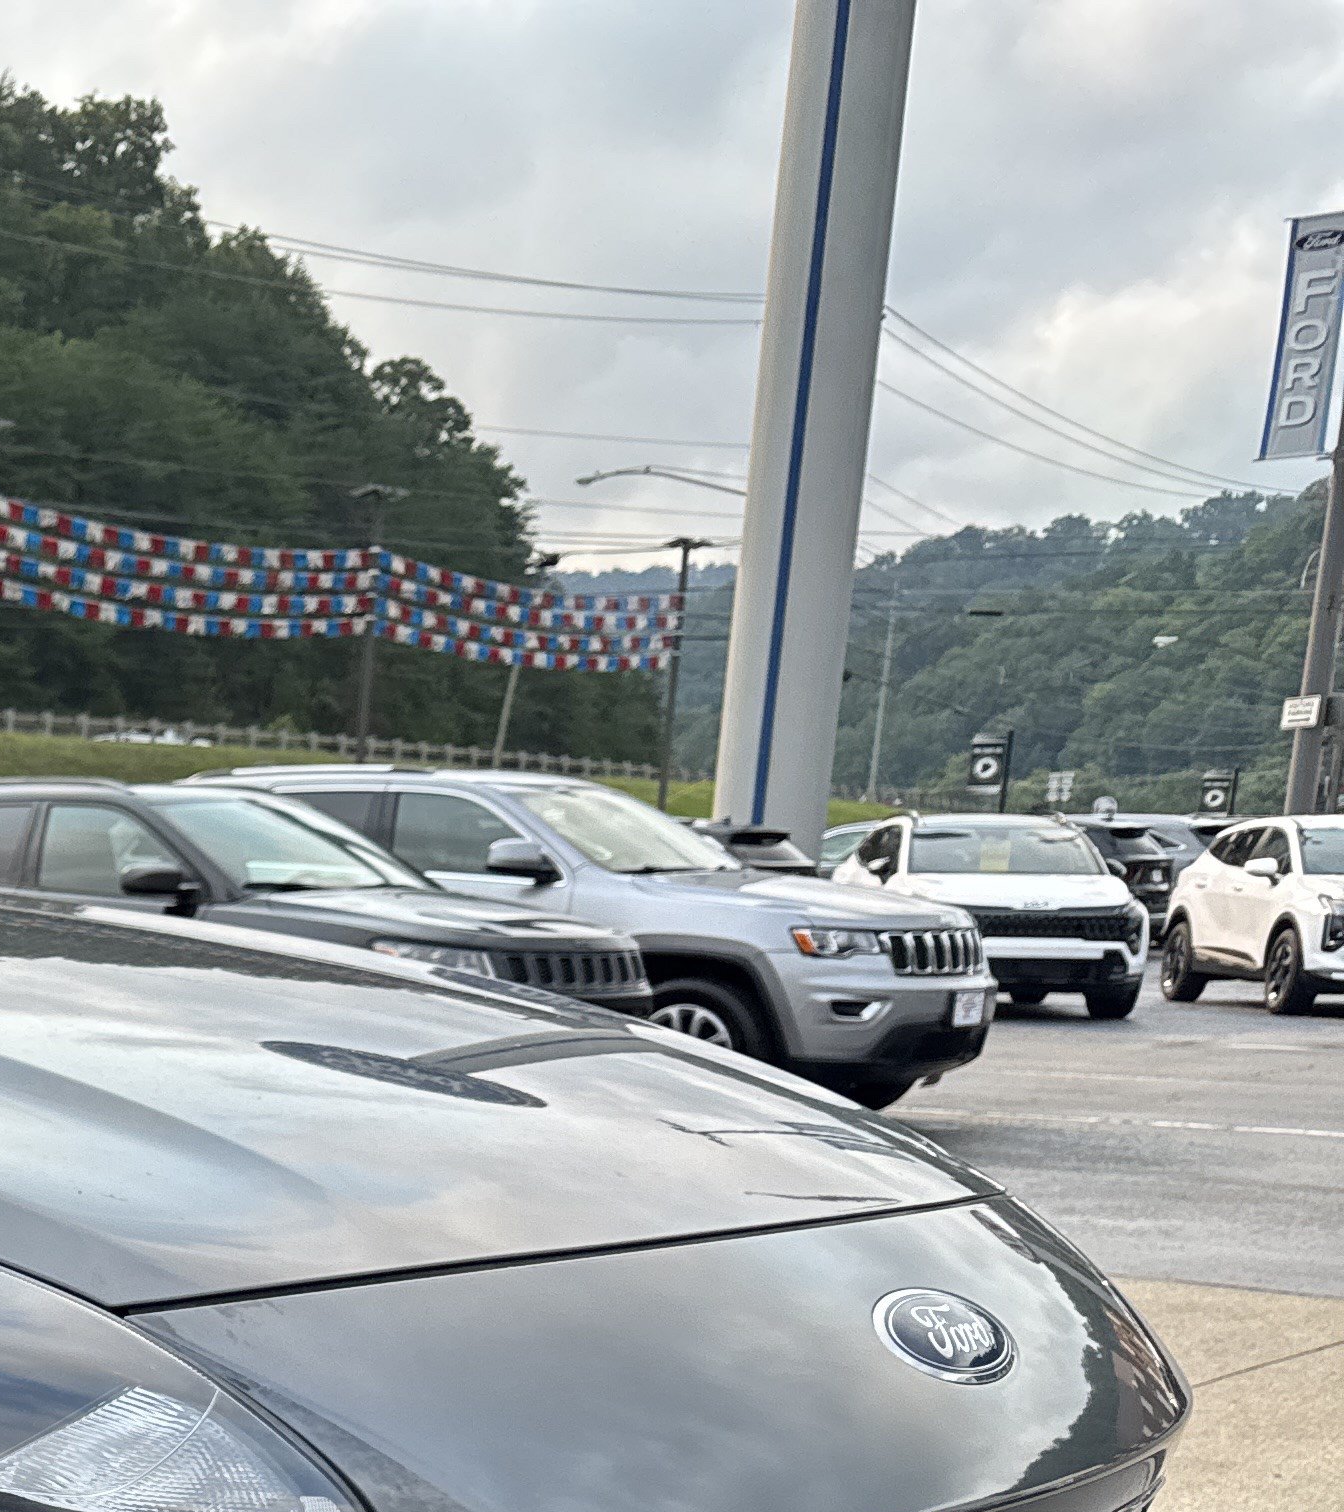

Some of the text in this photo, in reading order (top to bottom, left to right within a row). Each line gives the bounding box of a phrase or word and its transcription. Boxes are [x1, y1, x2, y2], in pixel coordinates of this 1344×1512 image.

[1305, 231, 1342, 250] Ford
[1278, 267, 1339, 427] FORD
[910, 1305, 997, 1359] Ford
